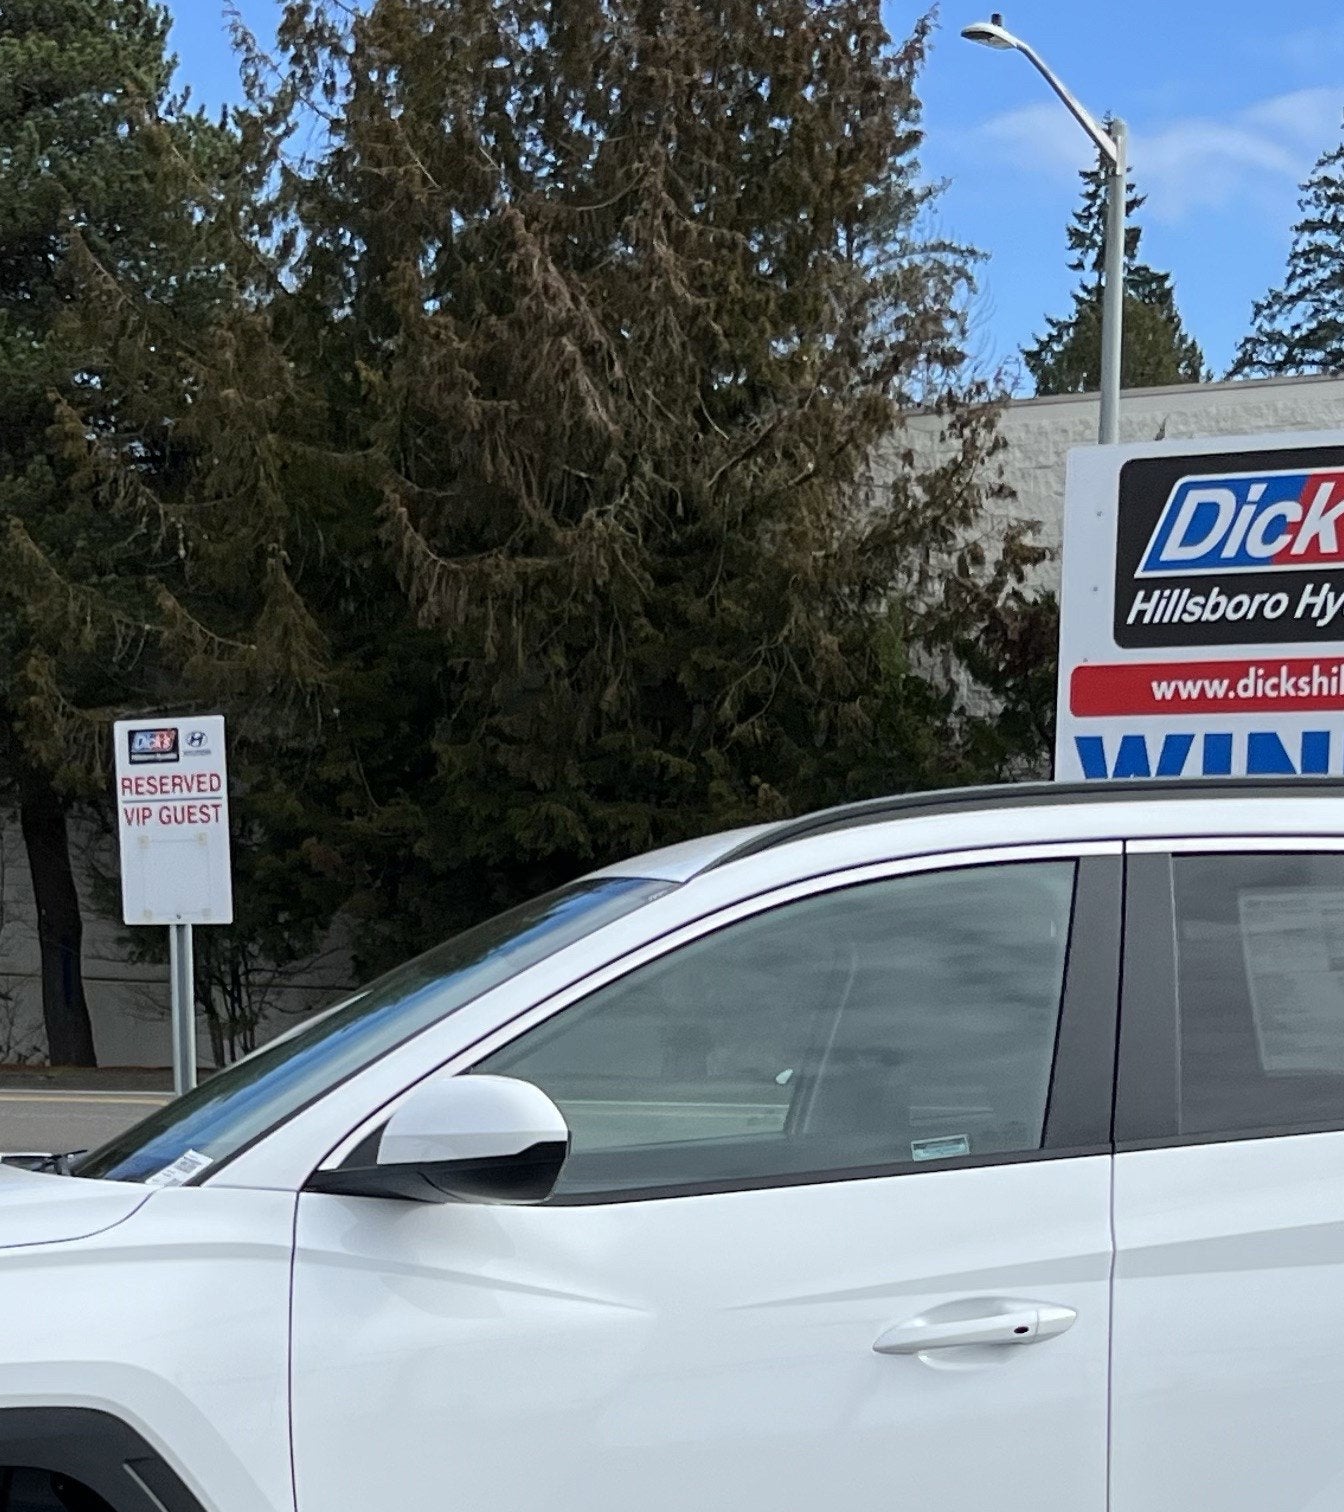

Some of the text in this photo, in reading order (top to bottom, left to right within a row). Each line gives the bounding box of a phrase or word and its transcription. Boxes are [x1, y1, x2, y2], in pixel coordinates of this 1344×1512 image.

[1126, 583, 1289, 625] Hillsboro
[120, 773, 222, 796] RESERVED
[123, 804, 222, 827] VIP GUEST
